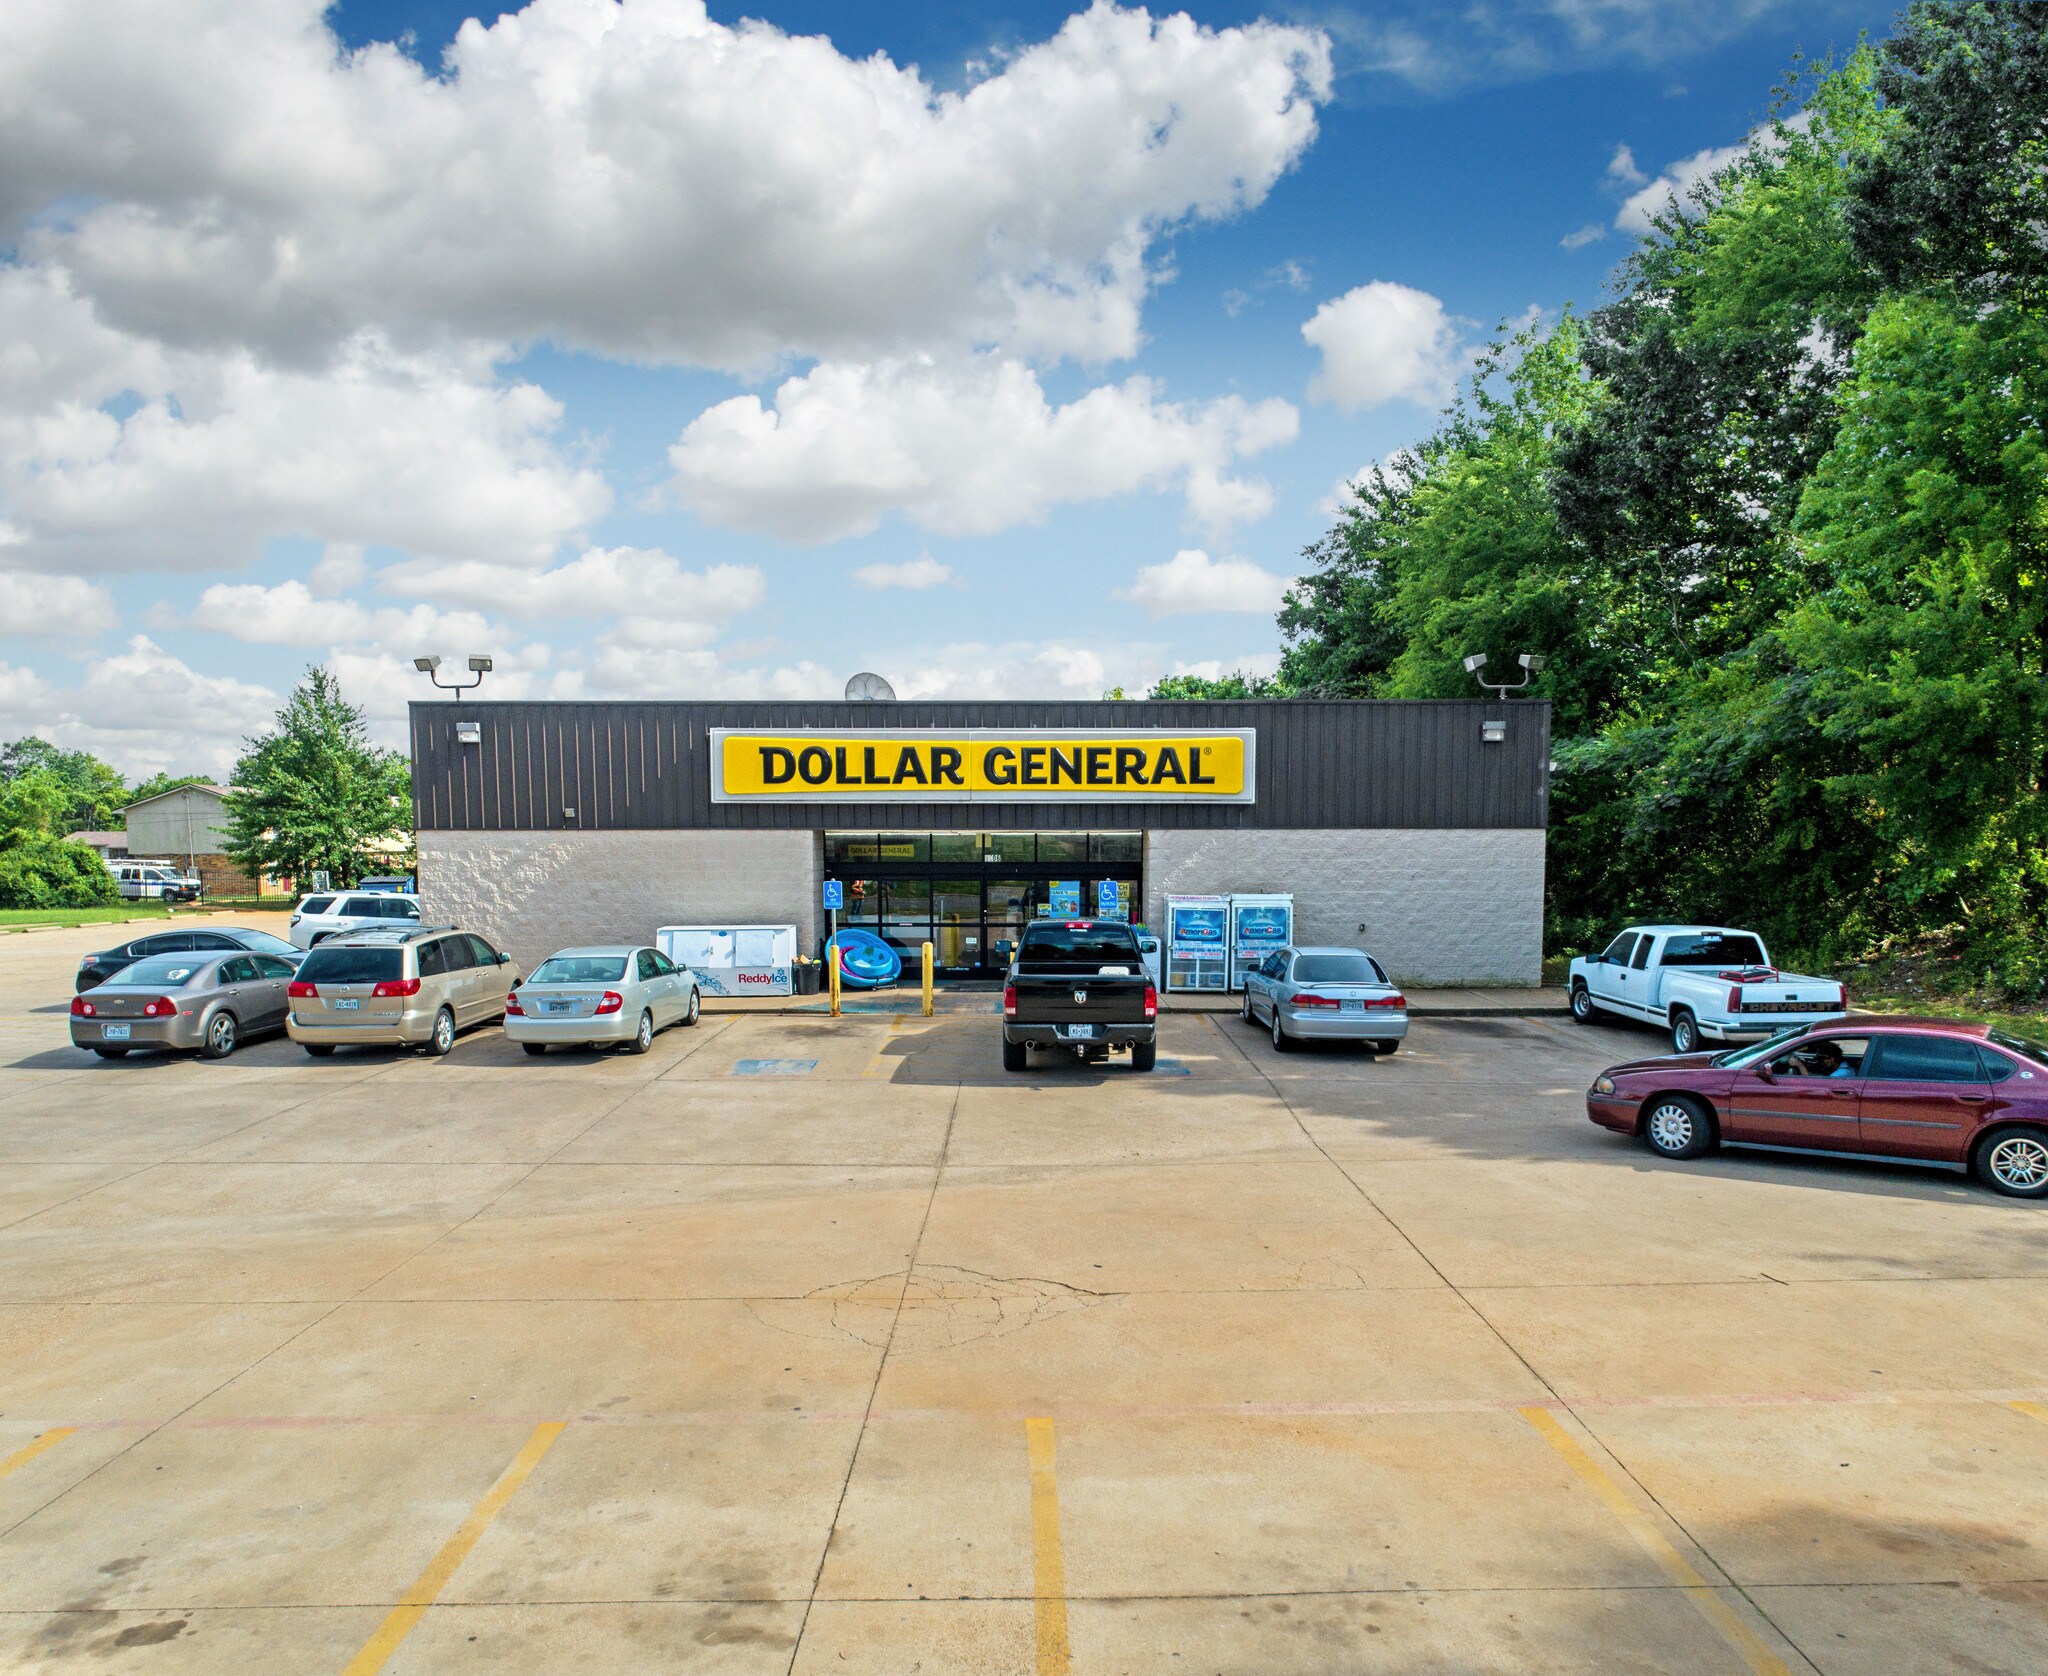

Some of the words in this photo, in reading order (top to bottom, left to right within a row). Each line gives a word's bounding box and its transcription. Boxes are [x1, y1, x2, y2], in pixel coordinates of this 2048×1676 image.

[759, 746, 965, 785] DOLLAR
[850, 846, 878, 855] DOLLAR
[880, 846, 912, 855] GENERAL
[1180, 928, 1217, 936] AmeriGas
[1244, 926, 1282, 935] AmeriGas
[1748, 1002, 1834, 1012] CHEVROLET
